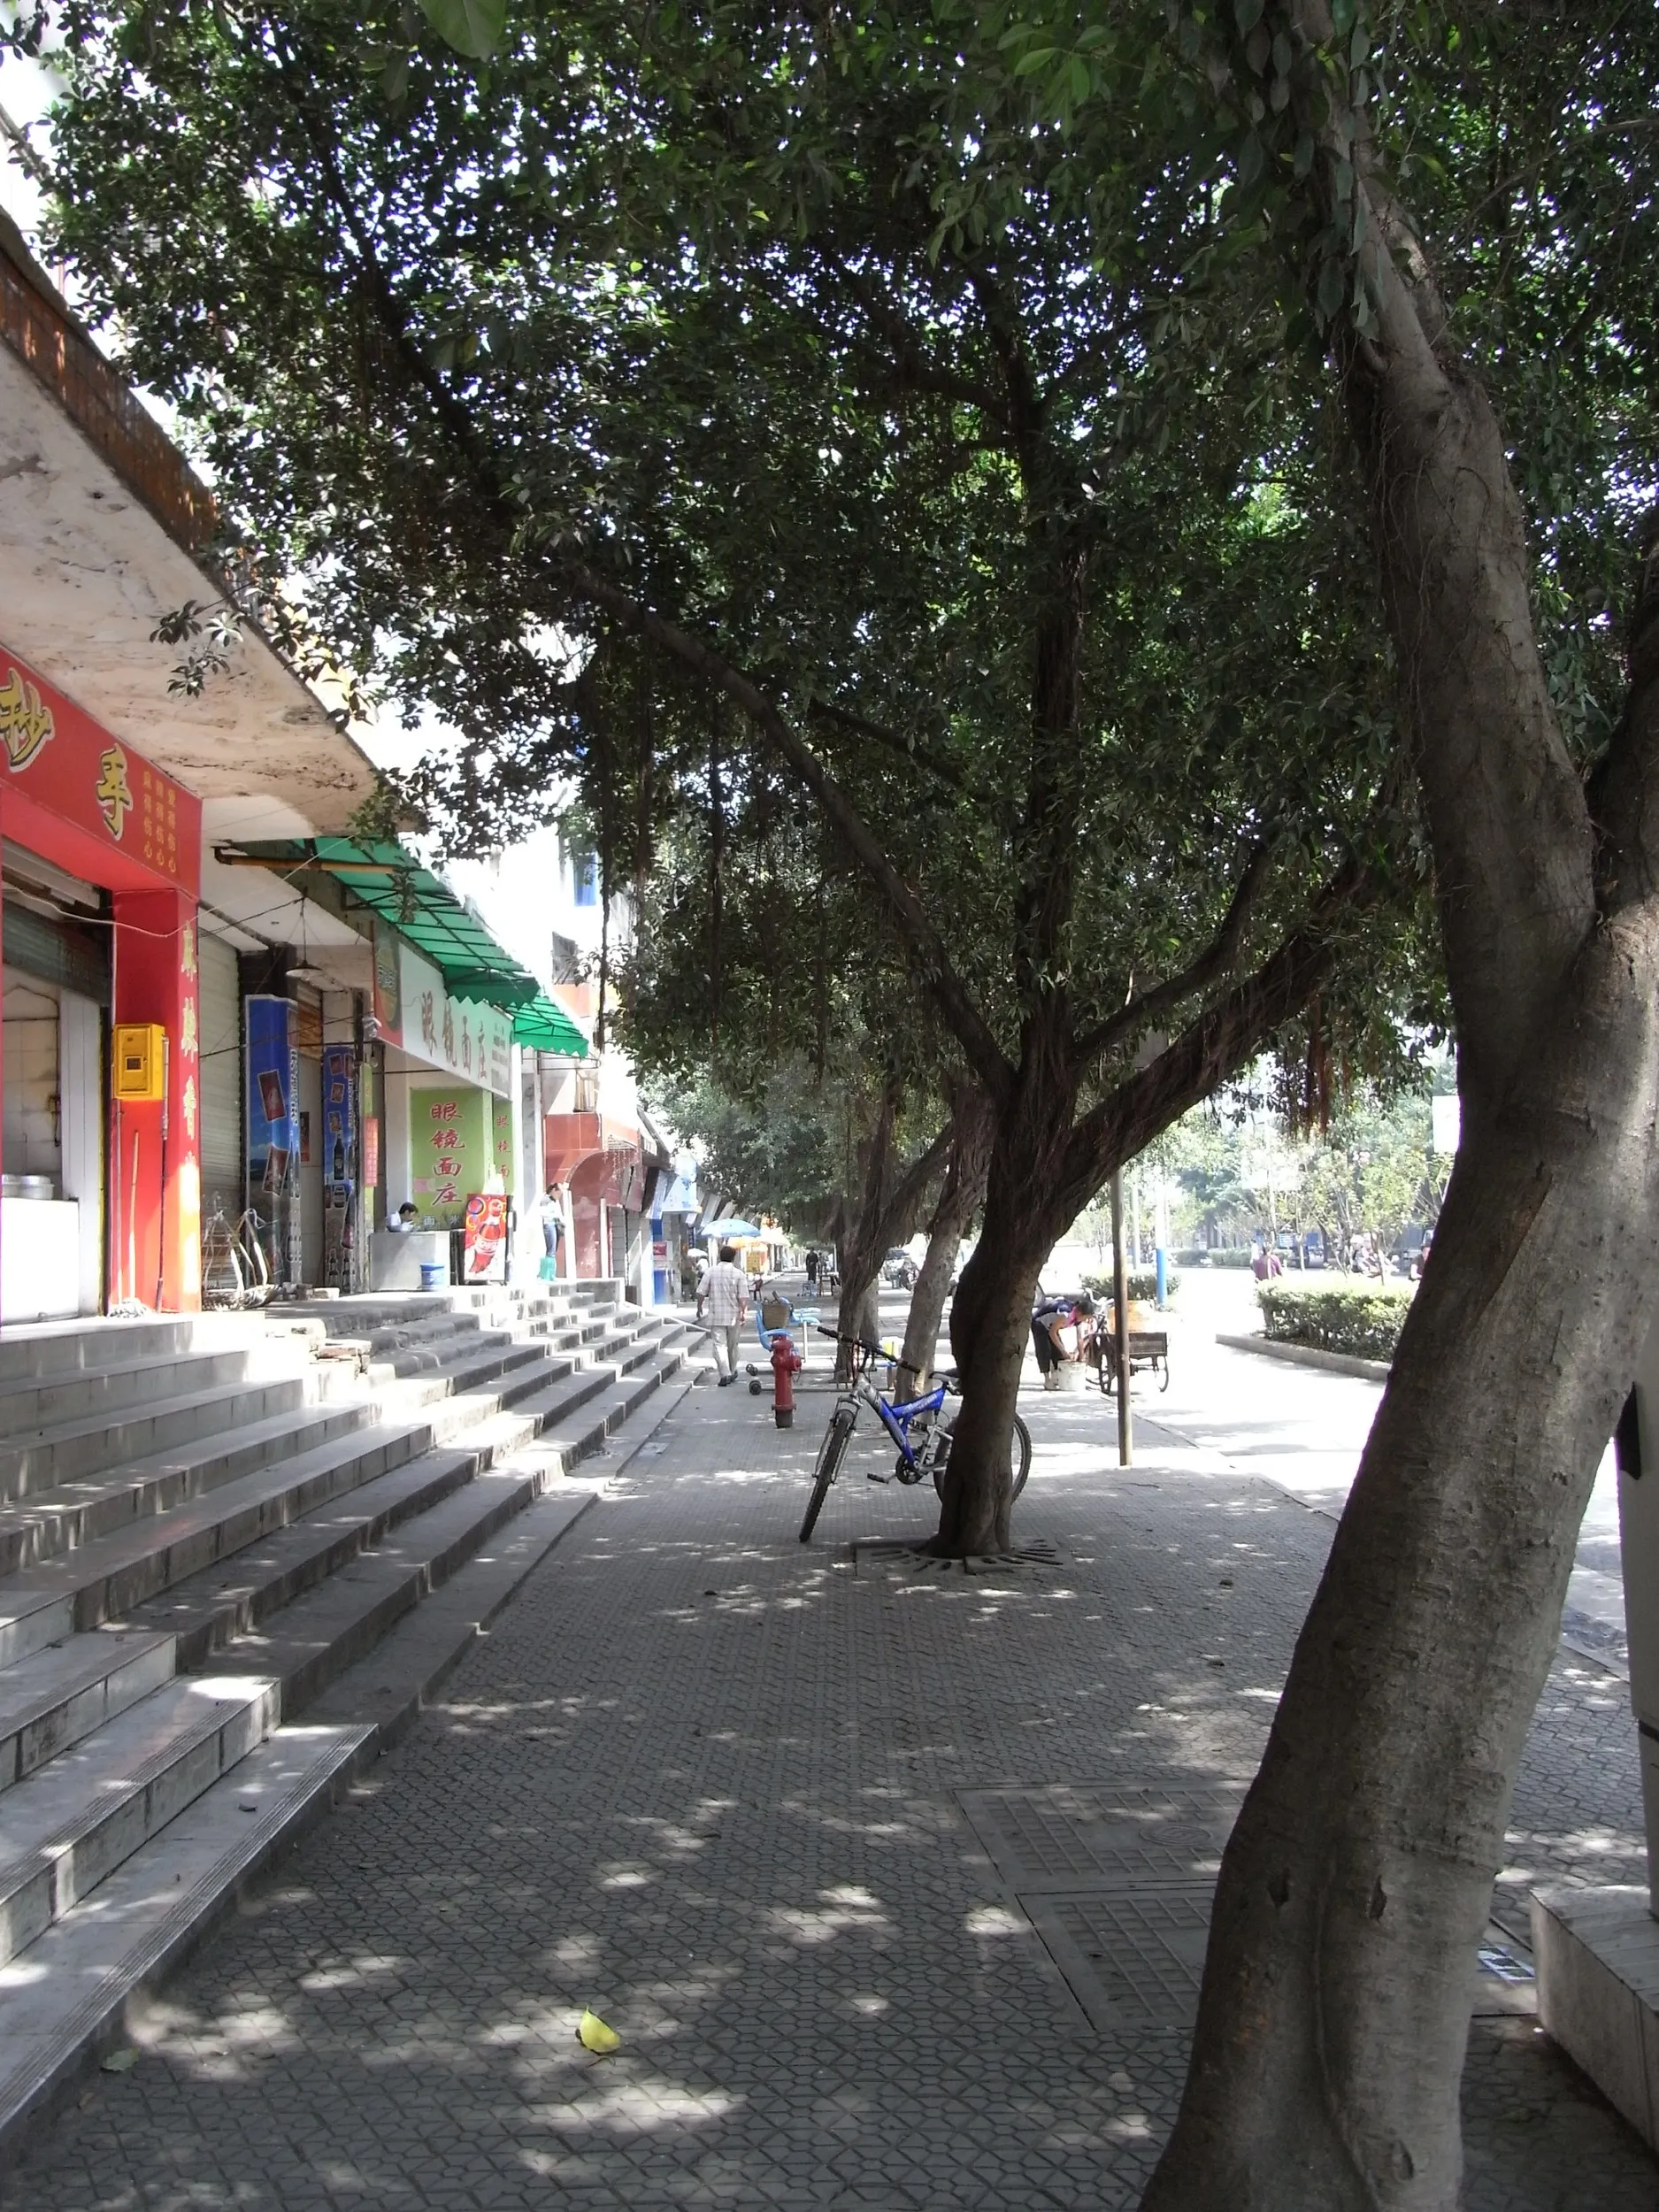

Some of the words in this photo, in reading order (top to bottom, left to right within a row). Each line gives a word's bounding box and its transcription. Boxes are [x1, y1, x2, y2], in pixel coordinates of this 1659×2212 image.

[419, 990, 488, 1079] 眼镜面庄
[430, 1102, 466, 1206] 眼镜面庄
[496, 1115, 511, 1194] 眼镜面
